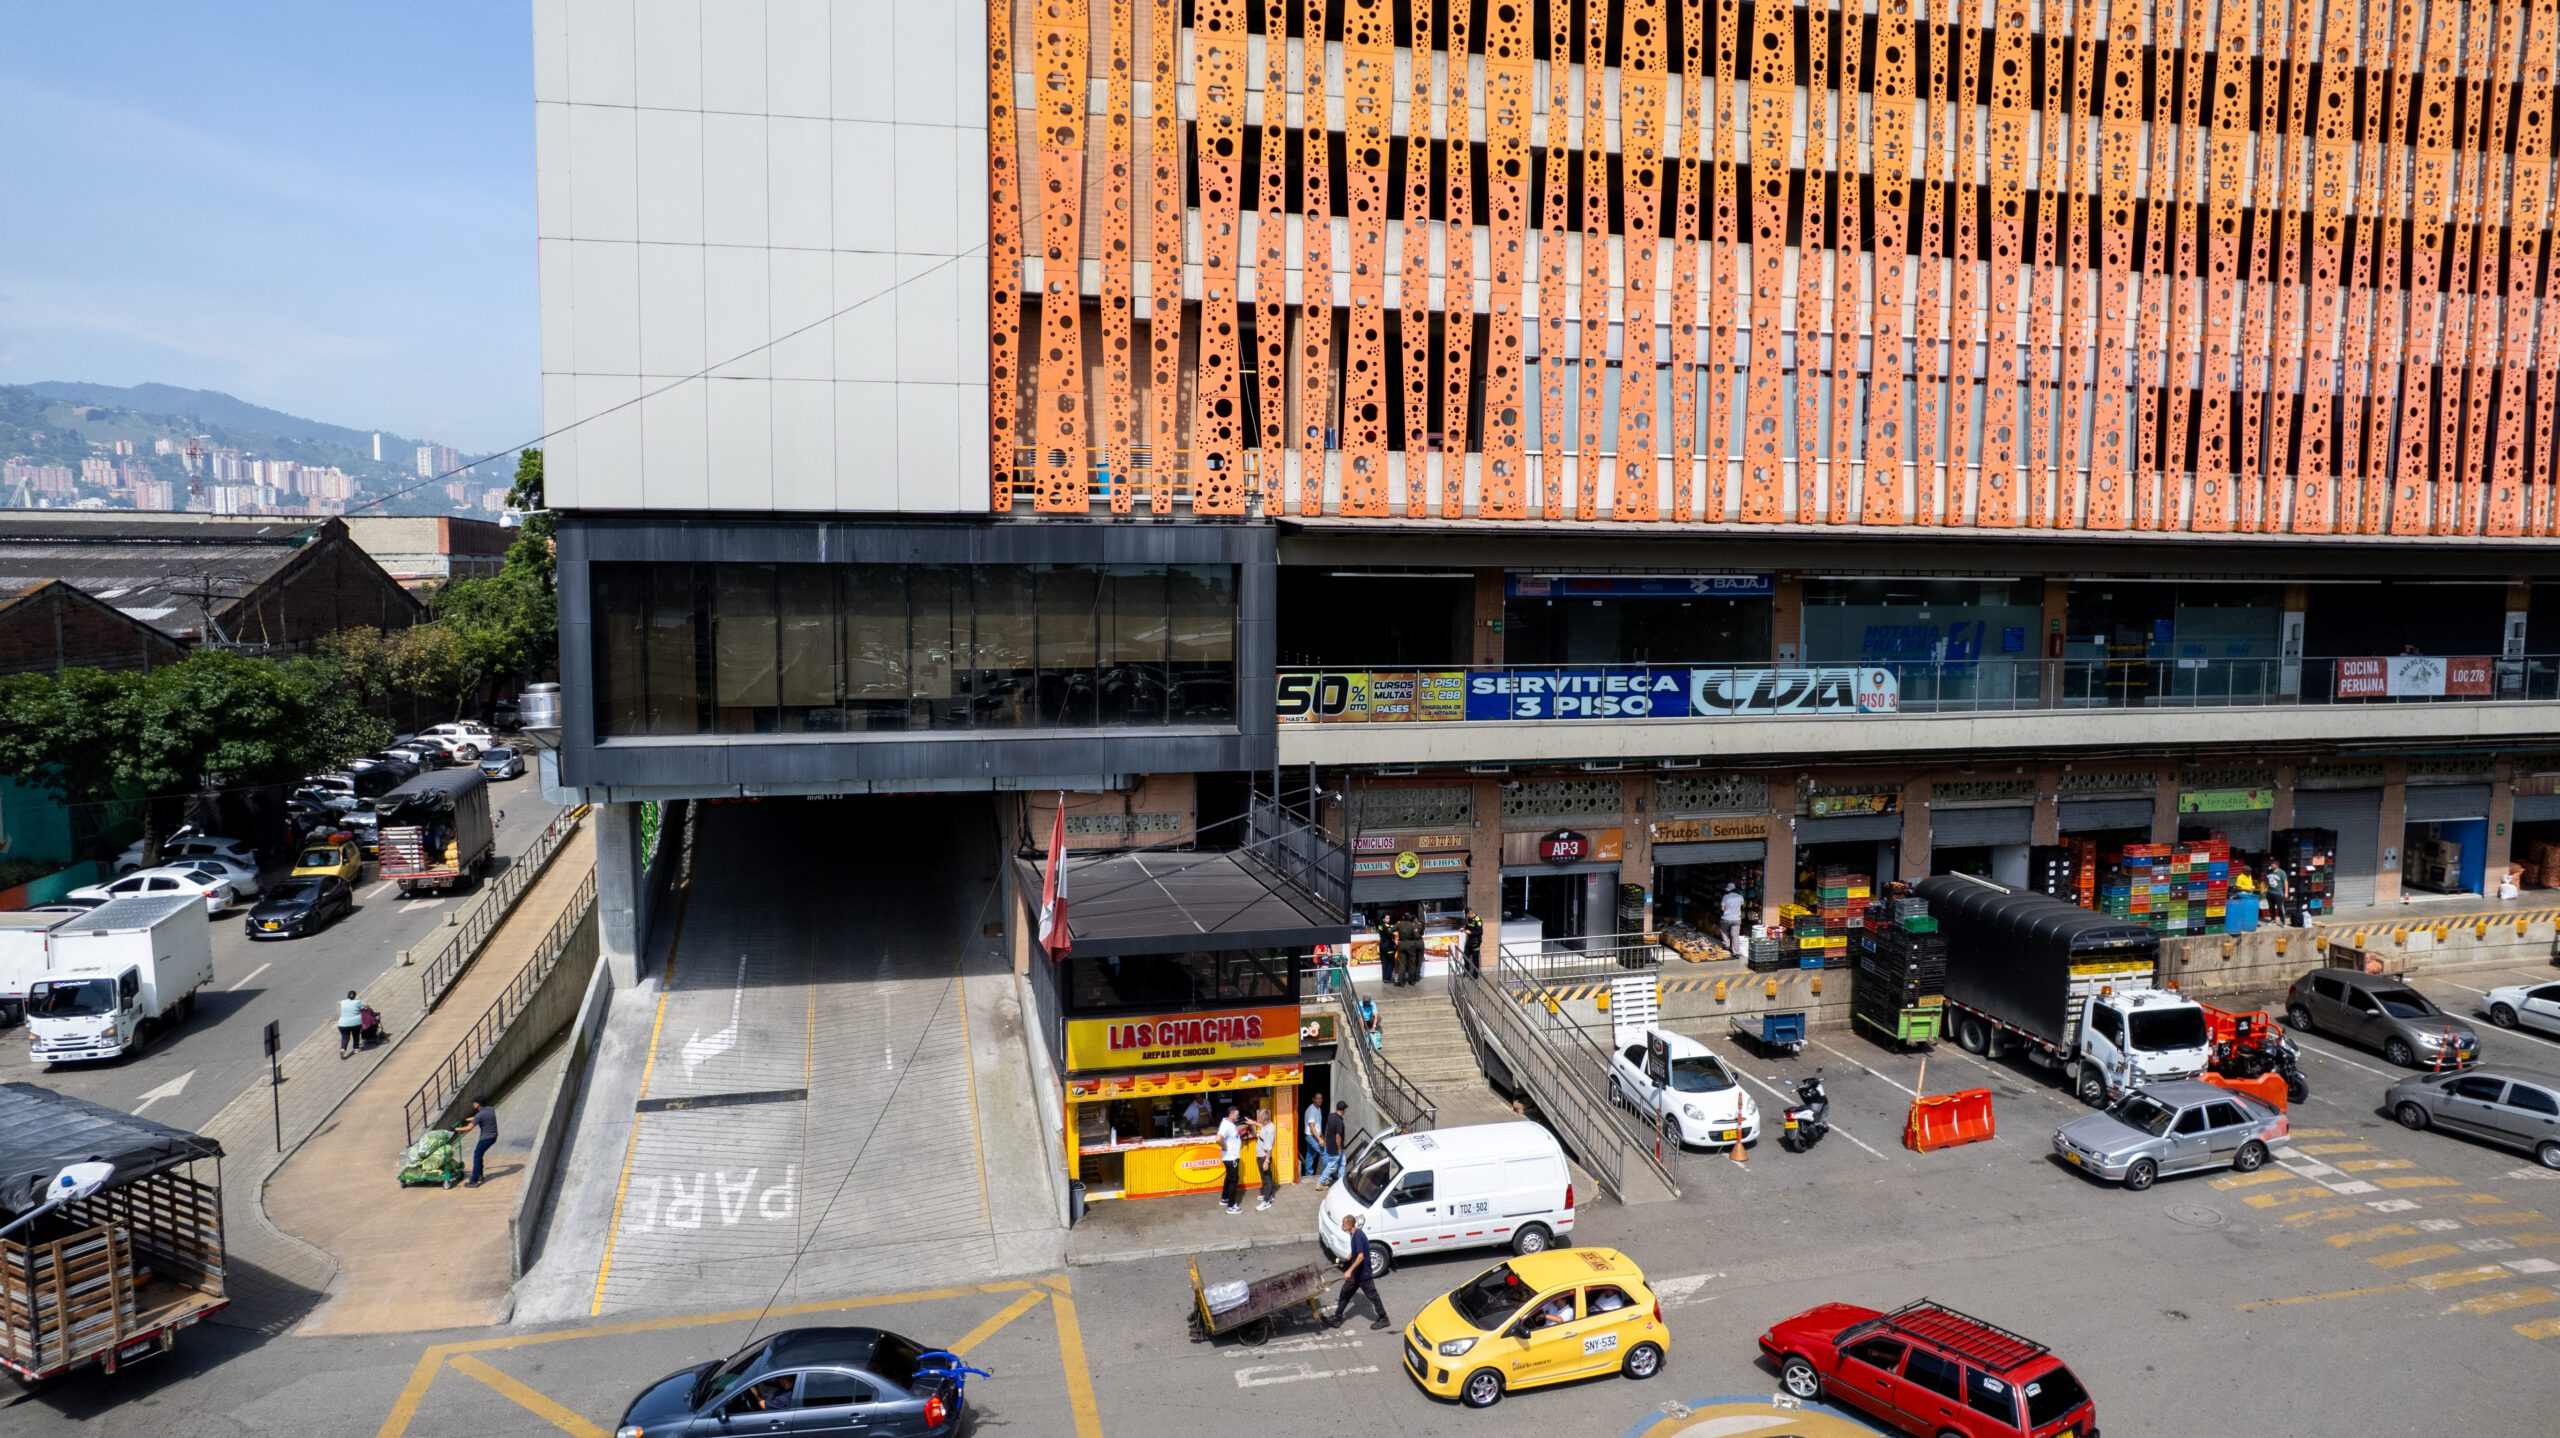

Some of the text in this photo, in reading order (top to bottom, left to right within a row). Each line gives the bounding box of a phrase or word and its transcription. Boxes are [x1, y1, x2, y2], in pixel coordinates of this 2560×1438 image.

[1713, 578, 1768, 589] BAJAJ
[2343, 661, 2379, 676] COCINA
[2453, 669, 2485, 682] LOC 278
[1373, 680, 1414, 690] CURSOS
[1421, 678, 1461, 688] 2 PISO
[1472, 674, 1680, 695] SERVITECA
[2340, 678, 2385, 692] PERUANA
[1276, 675, 1350, 716] 50
[1373, 690, 1412, 700] MULTAS
[1421, 690, 1461, 700] LC 288
[1702, 671, 1856, 710] CDA
[1515, 694, 1653, 717] 3 PISO
[1861, 692, 1896, 707] PISO 3
[1349, 703, 1367, 711] DTO
[1376, 705, 1410, 714] PASES
[1657, 826, 1700, 839] Frutos
[1713, 823, 1766, 836] Semillas
[1352, 837, 1394, 848] DOMICILIOS
[1552, 841, 1578, 856] AP-3
[1423, 857, 1462, 868] LECHONA
[1109, 1015, 1263, 1050] LAS CHACHAS
[1142, 1047, 1216, 1060] AREPAS DE CHOCOLO
[1182, 1160, 1194, 1169] LAS
[1194, 1158, 1221, 1168] CHACHAS
[622, 1163, 796, 1234] PARE
